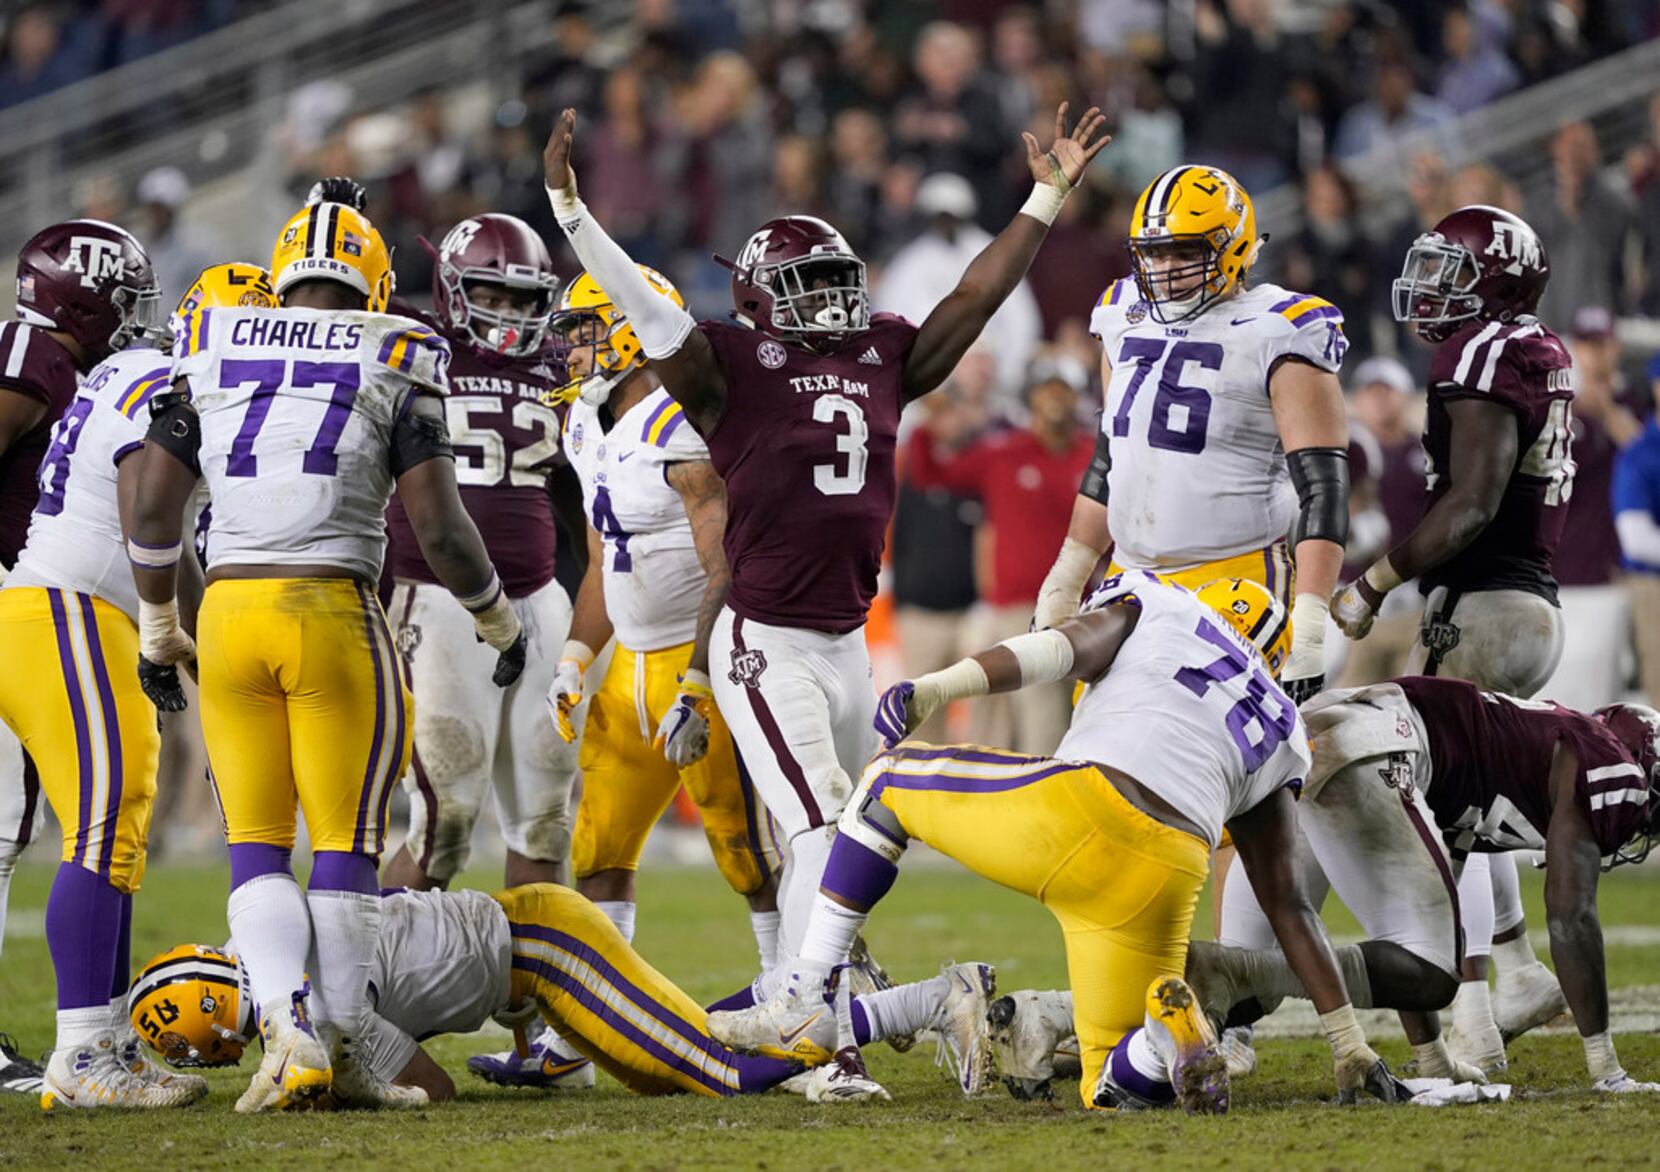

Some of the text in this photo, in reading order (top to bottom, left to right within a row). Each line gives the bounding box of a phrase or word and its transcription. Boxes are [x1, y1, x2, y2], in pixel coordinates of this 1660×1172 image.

[292, 259, 349, 275] TIGERS
[231, 318, 364, 351] CHARLES
[1164, 328, 1189, 338] LSU
[759, 343, 785, 367] SEC
[453, 376, 513, 394] TEXAS
[842, 379, 869, 398] A&M
[1113, 337, 1224, 454] 76
[219, 359, 361, 477] 77
[445, 395, 560, 487] 52
[812, 394, 869, 495] 3
[592, 485, 632, 573] 4
[1231, 600, 1250, 615] 20
[1173, 616, 1297, 775] 78
